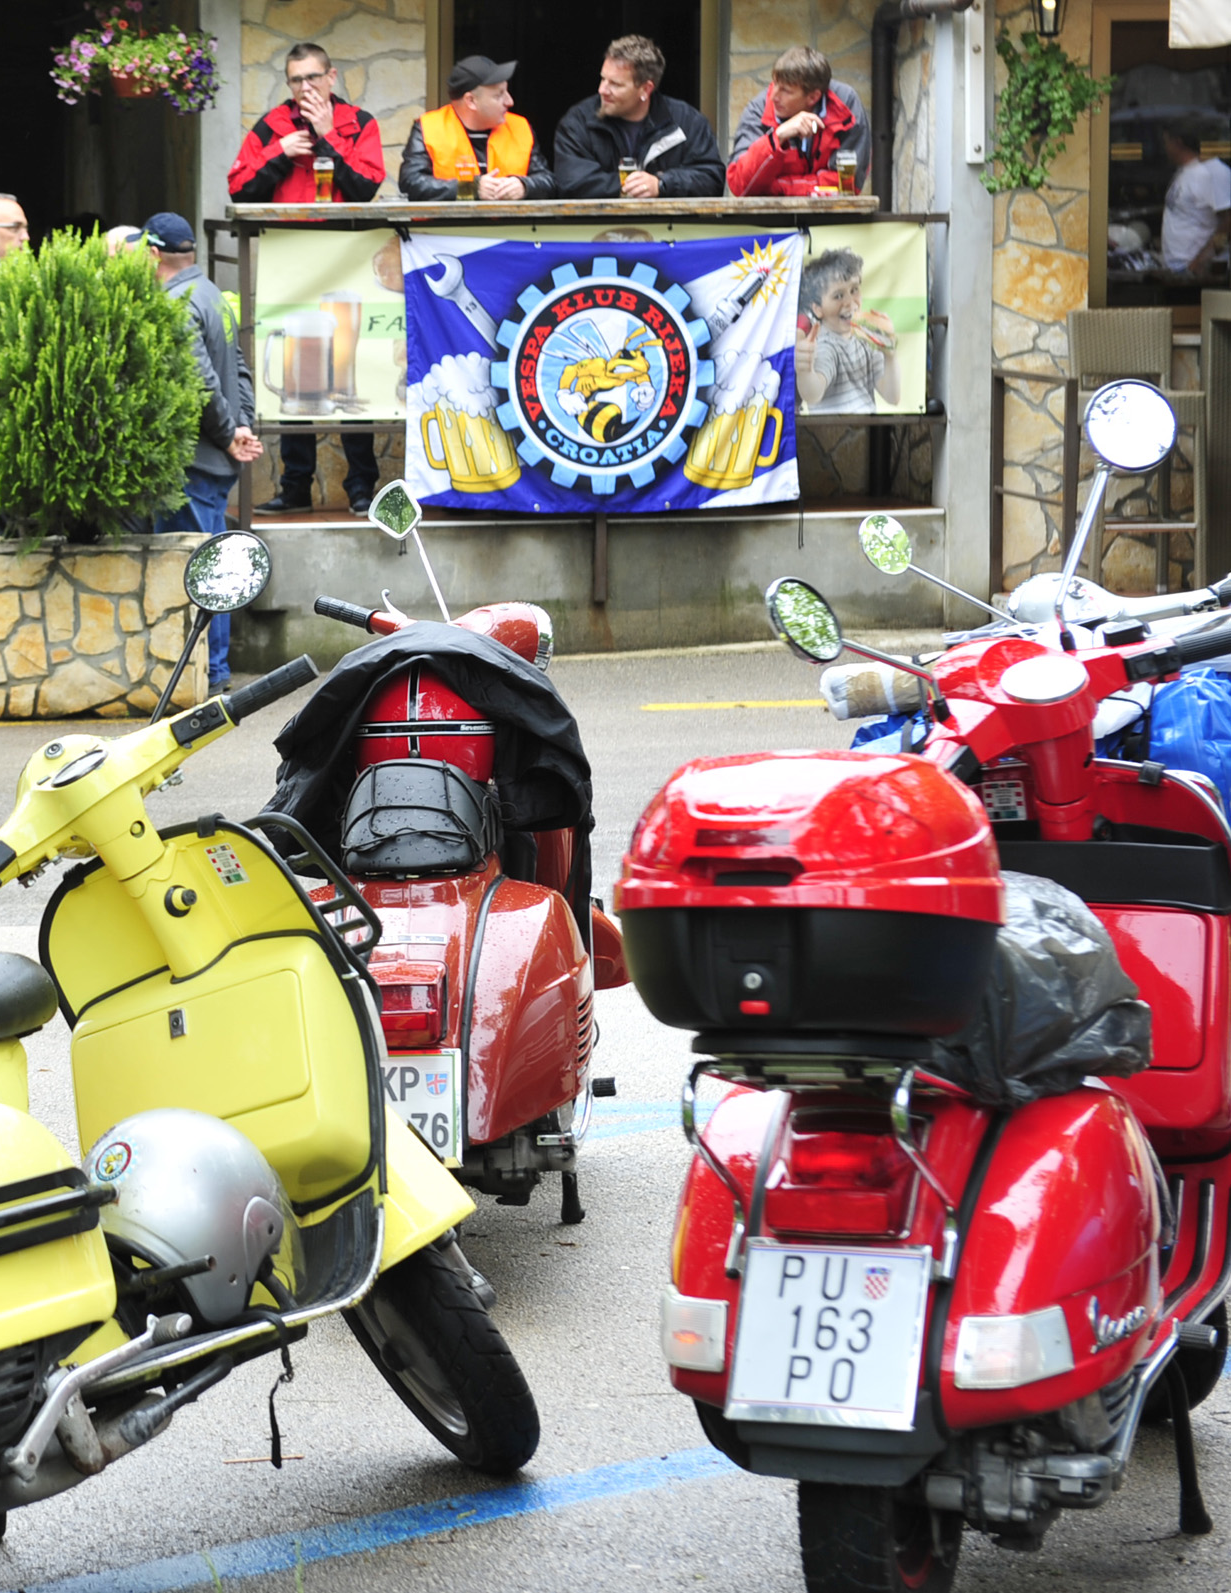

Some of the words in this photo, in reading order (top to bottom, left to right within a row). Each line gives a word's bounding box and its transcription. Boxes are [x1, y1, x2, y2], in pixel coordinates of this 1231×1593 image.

[368, 314, 407, 332] FA
[520, 325, 552, 422] VESPA
[551, 289, 638, 322] KLUB
[642, 304, 686, 418] RIJEKA
[545, 428, 664, 465] CROATIA
[380, 1066, 420, 1102] KP
[778, 1255, 849, 1301] PU
[791, 1305, 874, 1354] 163
